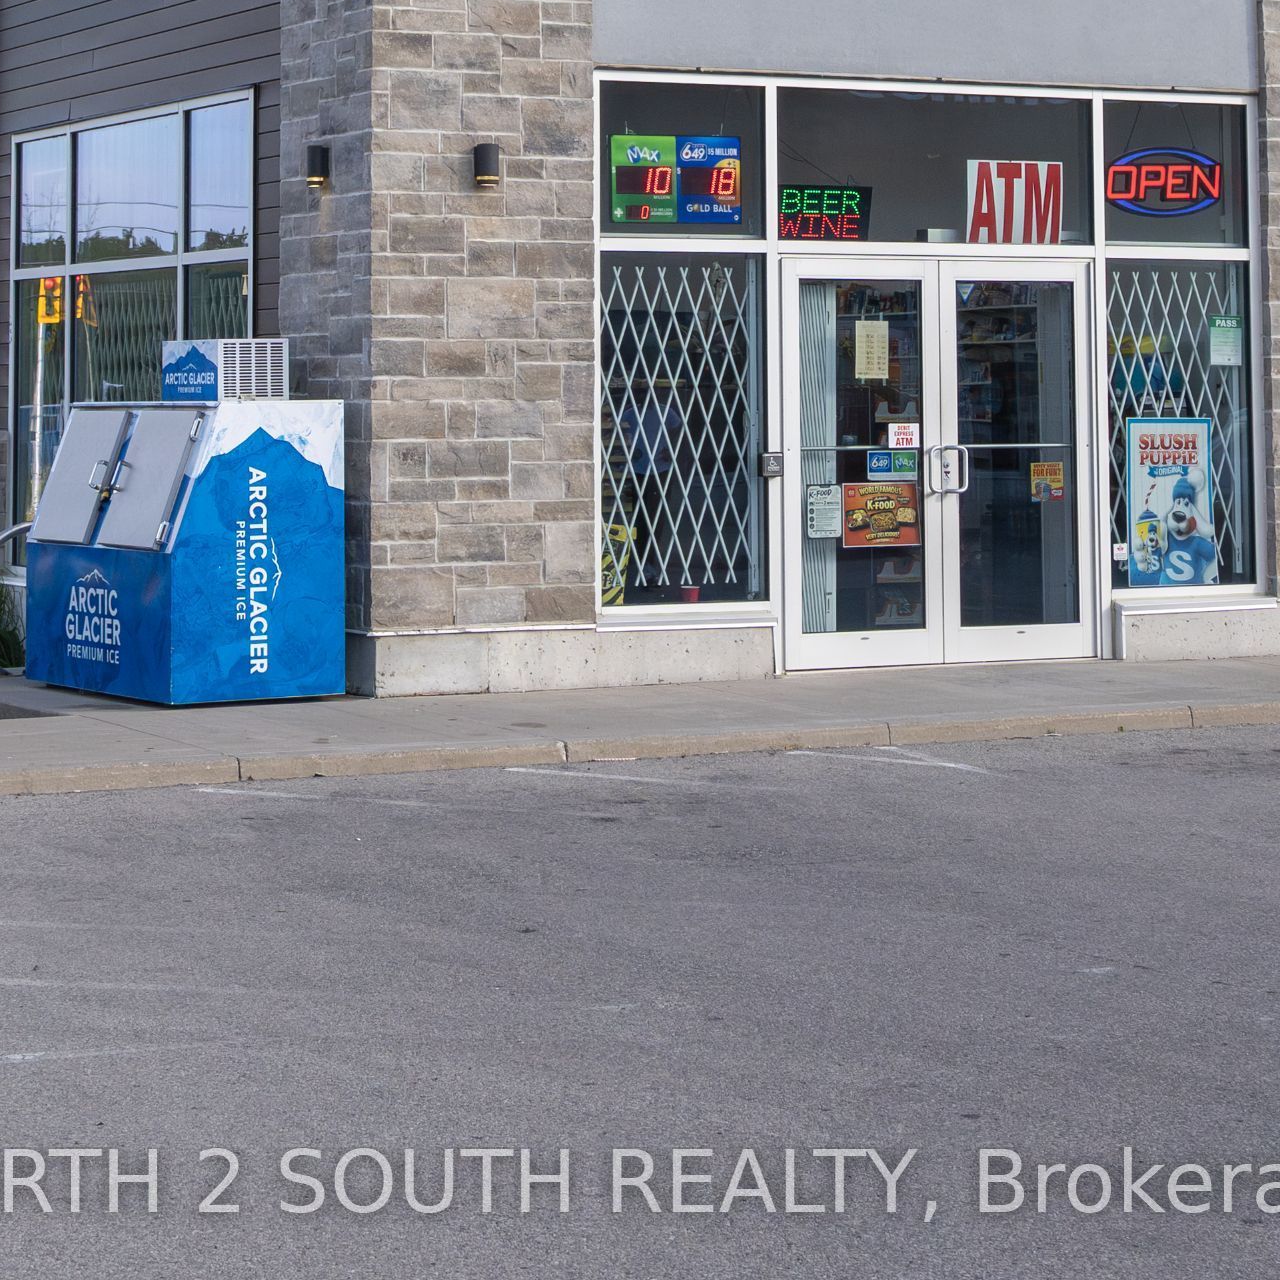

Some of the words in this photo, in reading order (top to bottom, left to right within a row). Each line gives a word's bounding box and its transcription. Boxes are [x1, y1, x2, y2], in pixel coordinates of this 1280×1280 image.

[627, 145, 660, 163] MAX
[715, 147, 738, 156] MILLION
[645, 167, 672, 194] 10
[710, 168, 736, 195] 18
[1106, 164, 1221, 199] OPEN
[712, 204, 733, 213] BALL
[781, 189, 861, 214] BEER
[968, 162, 1061, 244] ATM
[779, 213, 859, 239] WINE
[1215, 319, 1238, 328] PASS
[165, 372, 188, 385] ARCTIC
[188, 372, 215, 385] GLACIER
[895, 437, 913, 446] ATM
[1139, 433, 1197, 450] SLUSH
[809, 489, 832, 500] K-FOOD
[867, 500, 895, 510] K-FOOD
[248, 466, 268, 560] ARCTIC
[236, 520, 246, 590] PREMIUM
[1165, 550, 1195, 581] S
[68, 585, 118, 617] ARCTIC
[236, 597, 246, 621] ICE
[65, 613, 121, 646] GLACIER
[249, 567, 268, 675] GLACIER
[66, 643, 104, 662] PREMIUM
[106, 649, 120, 665] ICE
